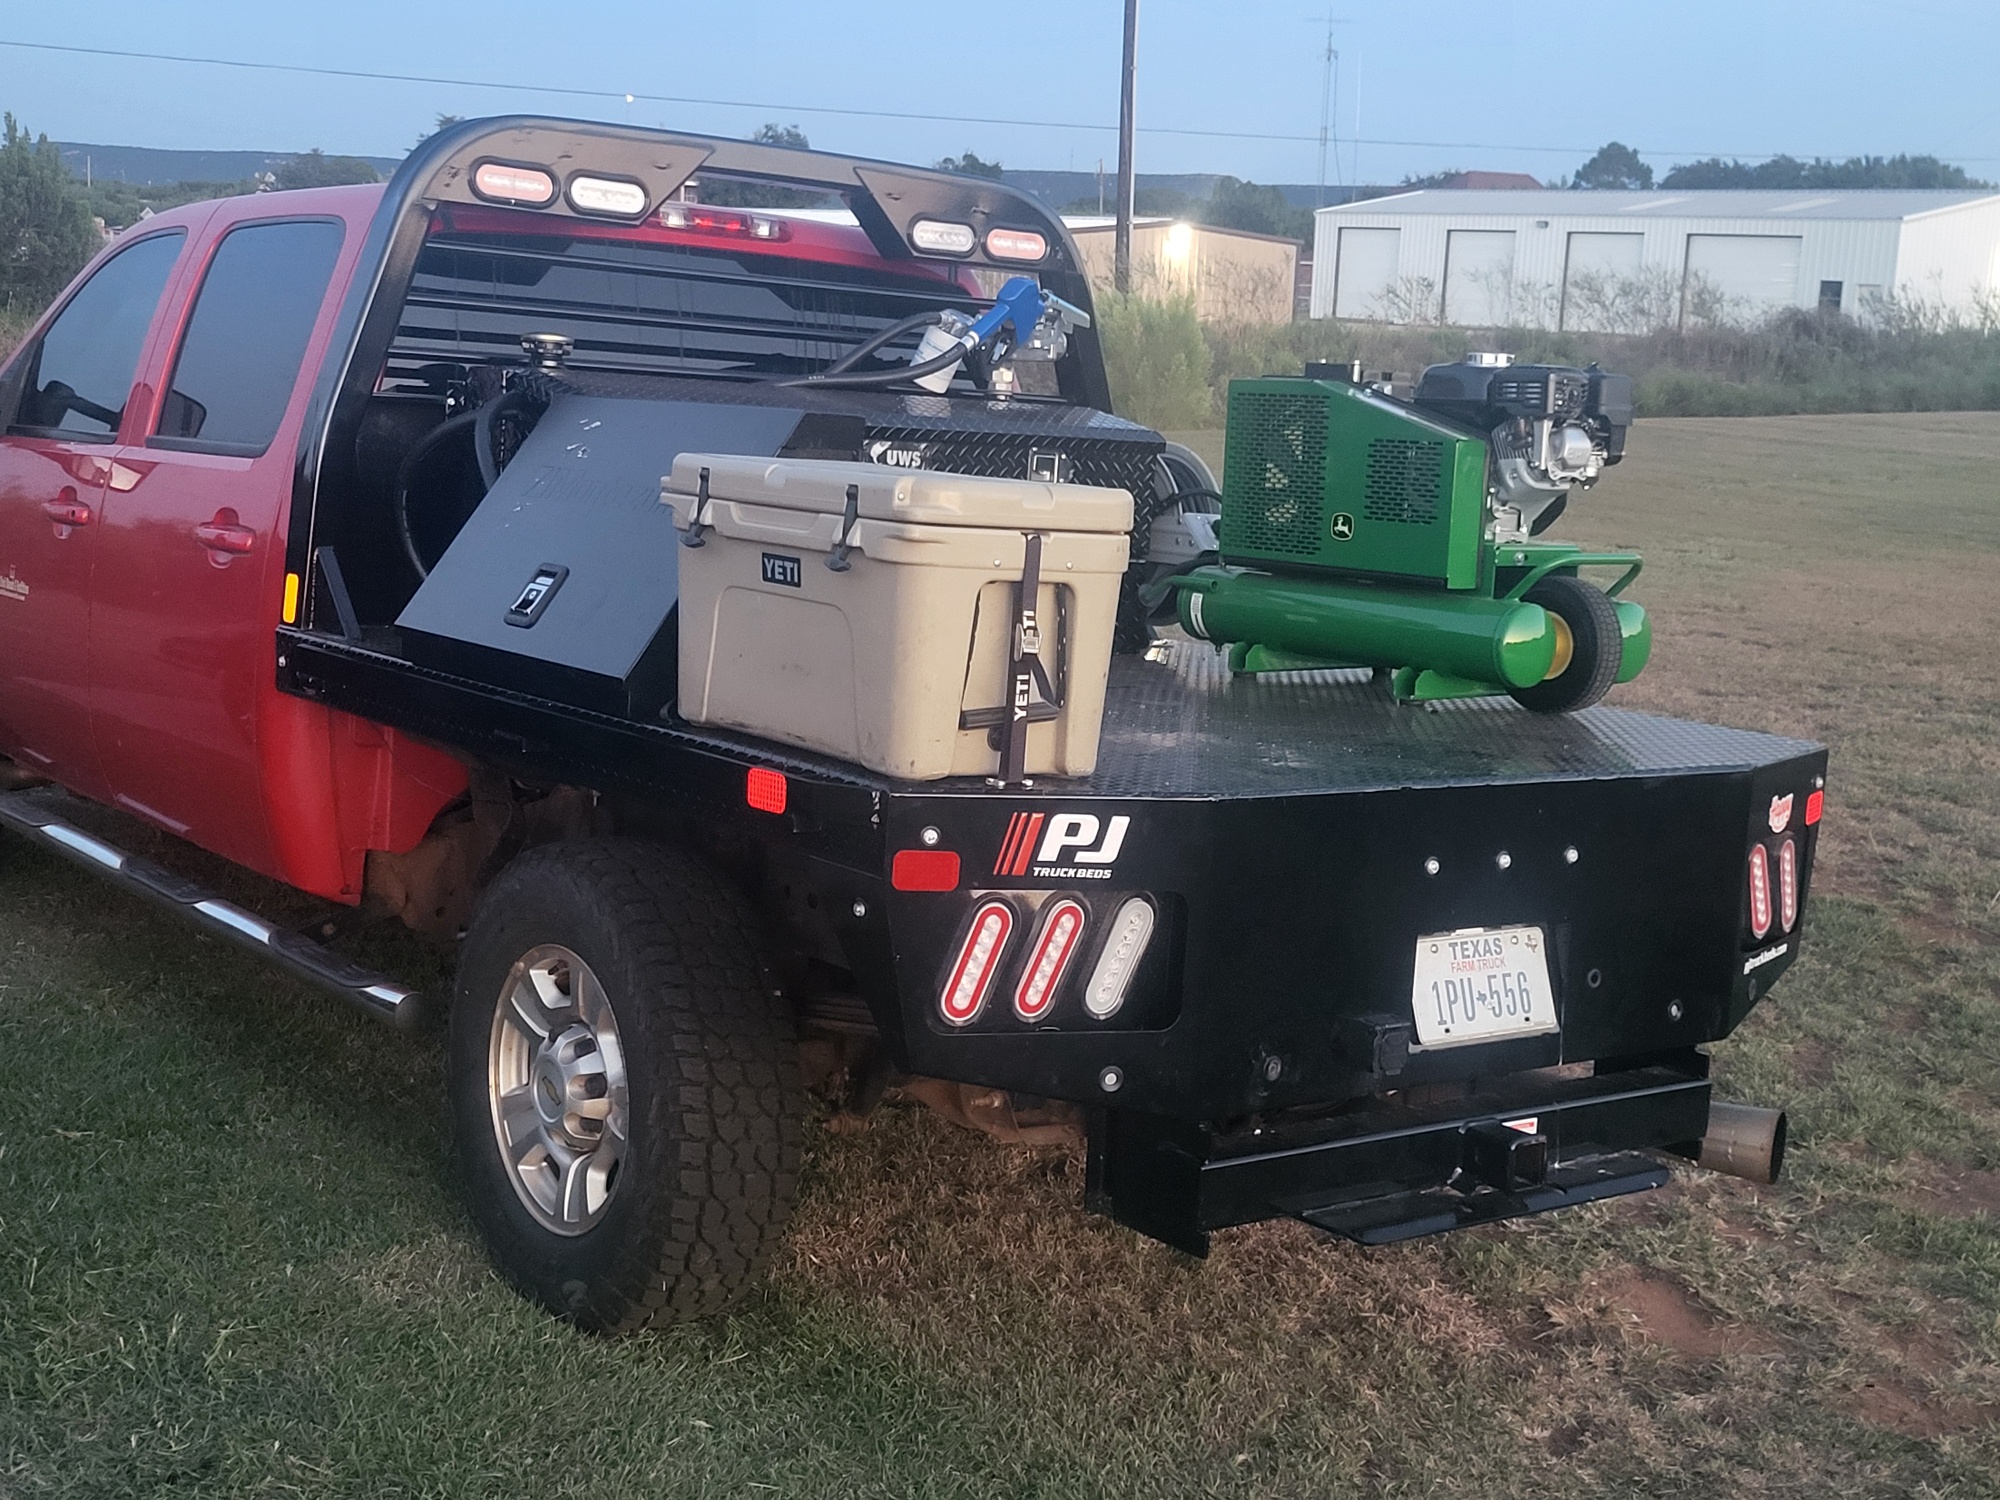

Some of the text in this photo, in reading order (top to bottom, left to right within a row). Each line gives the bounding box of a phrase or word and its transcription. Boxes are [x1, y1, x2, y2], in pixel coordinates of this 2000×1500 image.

[886, 450, 921, 467] UWS
[763, 557, 799, 583] YETI
[1014, 674, 1030, 721] YETI
[1036, 813, 1131, 864] PJ
[1448, 937, 1503, 960] TEXAS
[1450, 956, 1507, 973] FARM TRUCK
